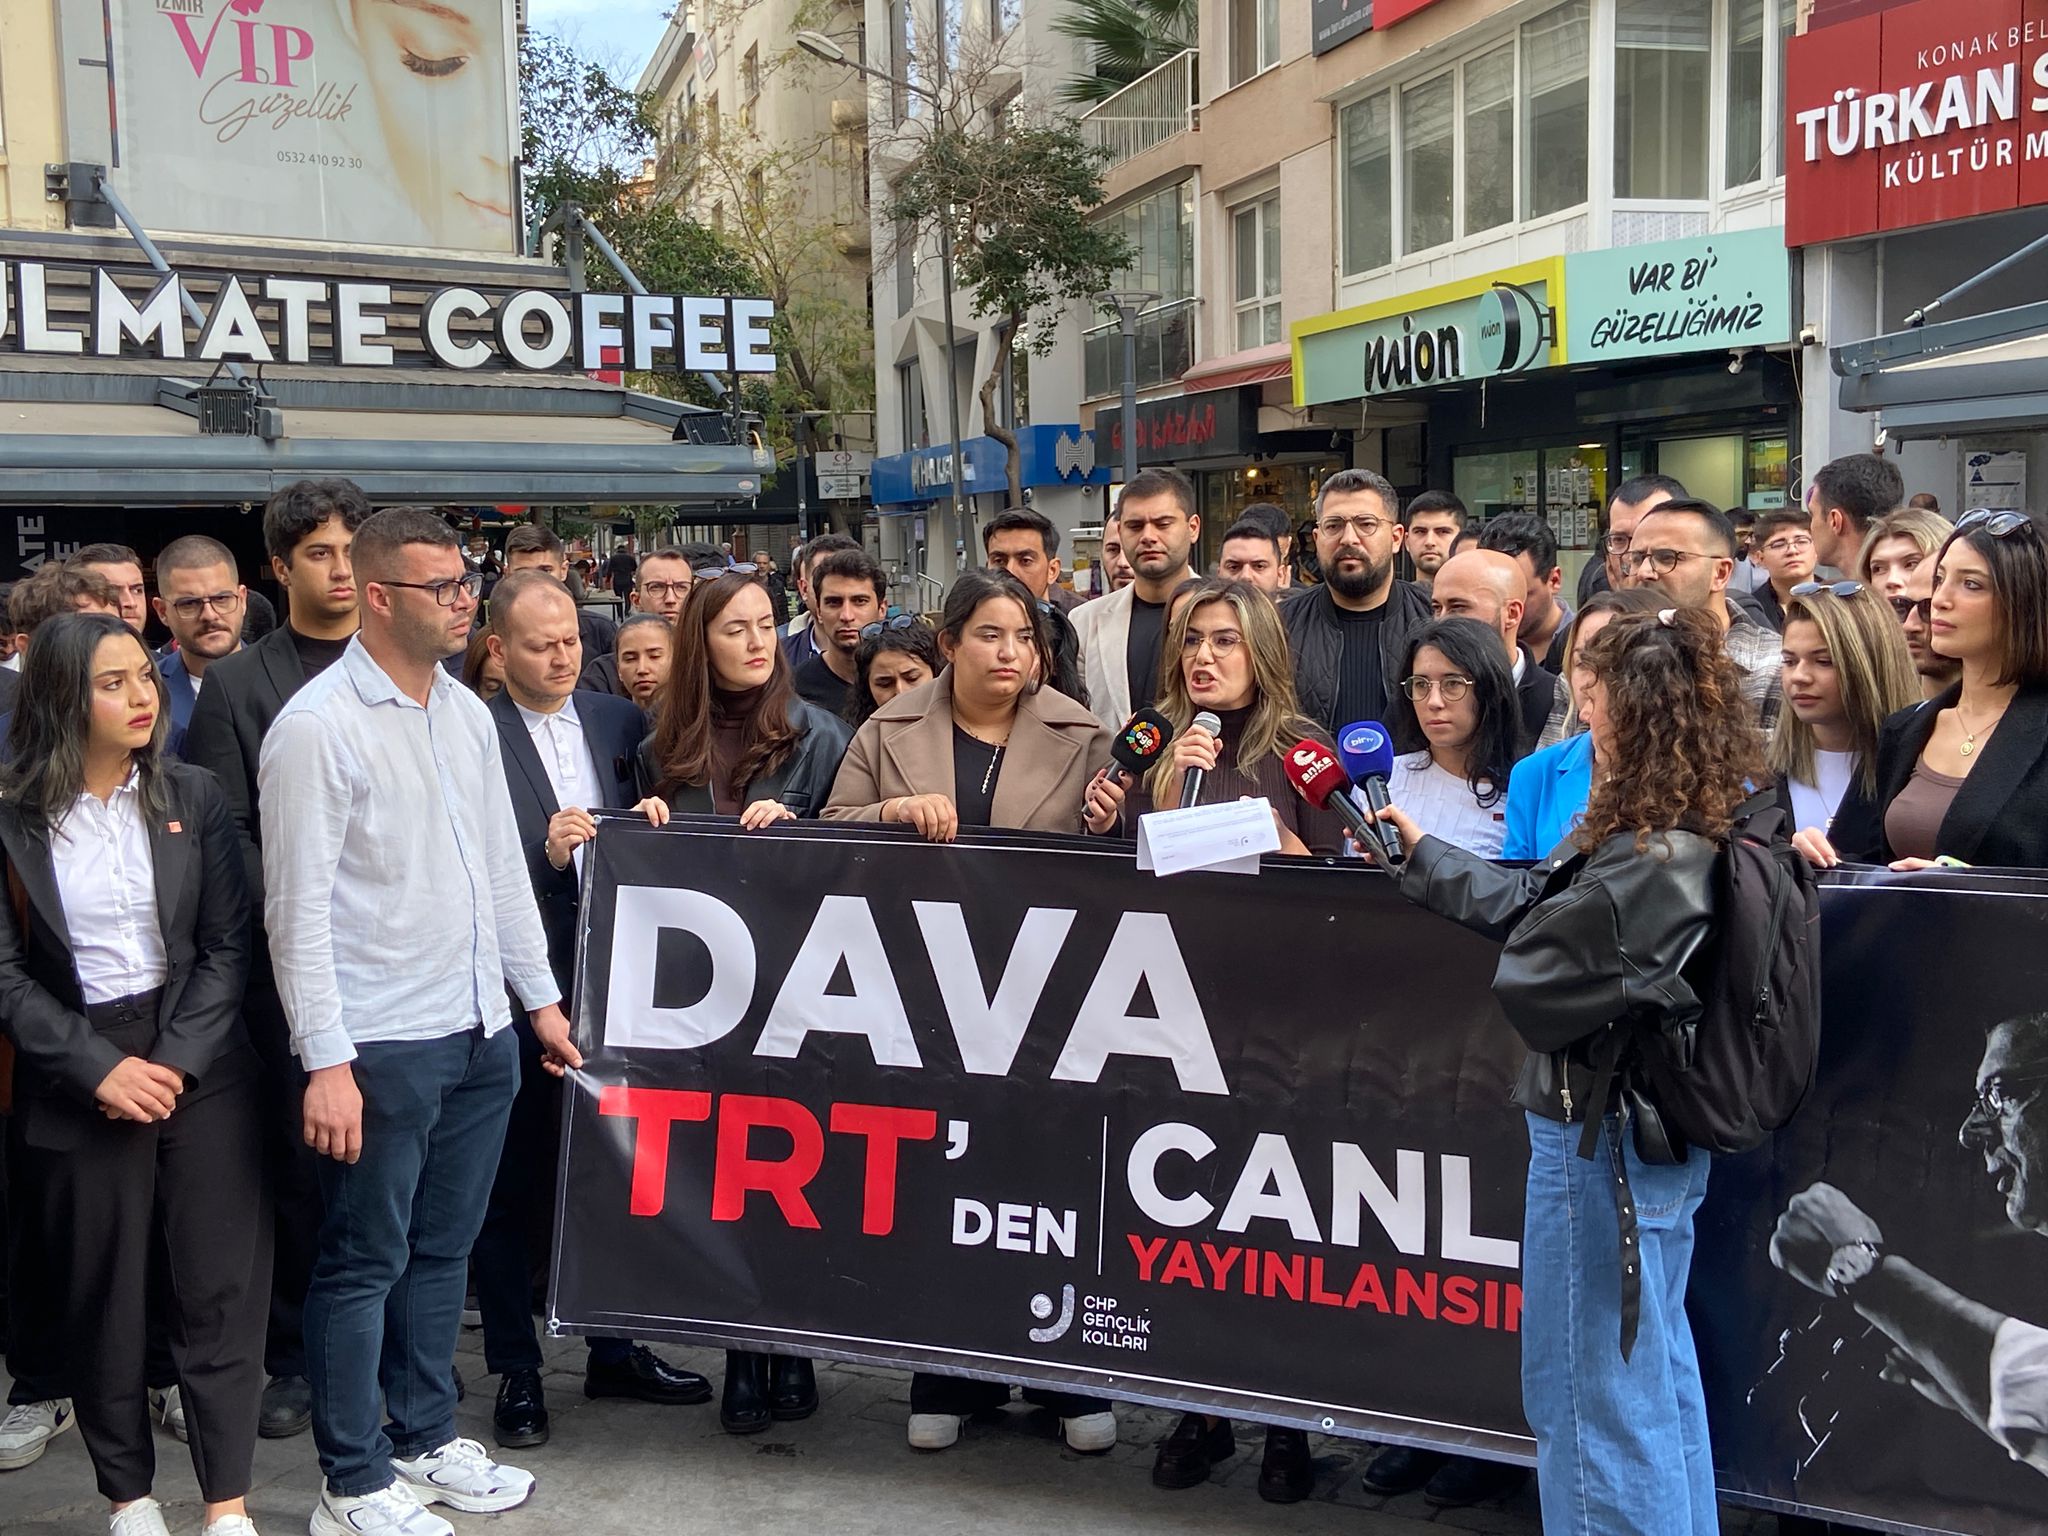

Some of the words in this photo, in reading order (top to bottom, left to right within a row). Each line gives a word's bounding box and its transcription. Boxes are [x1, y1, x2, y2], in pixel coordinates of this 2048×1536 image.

[157, 0, 314, 87] VIP
[1918, 32, 1998, 69] KONAK
[200, 67, 358, 142] Güzellik
[1796, 62, 2016, 163] TÜRKAN
[277, 151, 305, 164] 0532
[309, 152, 328, 166] 410
[331, 154, 345, 167] 92
[349, 156, 362, 169] 30
[1885, 137, 2013, 188] KÜLTÜR
[1629, 262, 1675, 295] VAR
[0, 262, 394, 366] LMATE
[424, 287, 777, 372] COFFEE
[1481, 320, 1501, 340] mion
[1590, 291, 1764, 348] GÜZELLİĞİMİZ
[1364, 316, 1465, 393] mion
[1135, 731, 1154, 747] ege
[1301, 756, 1331, 782] anka
[603, 884, 1230, 1095] DAVA
[952, 1198, 1077, 1258] DEN
[1082, 1312, 1151, 1334] GENÇLİK
[1083, 1295, 1117, 1311] CHP
[1082, 1329, 1147, 1352] KOLLARI
